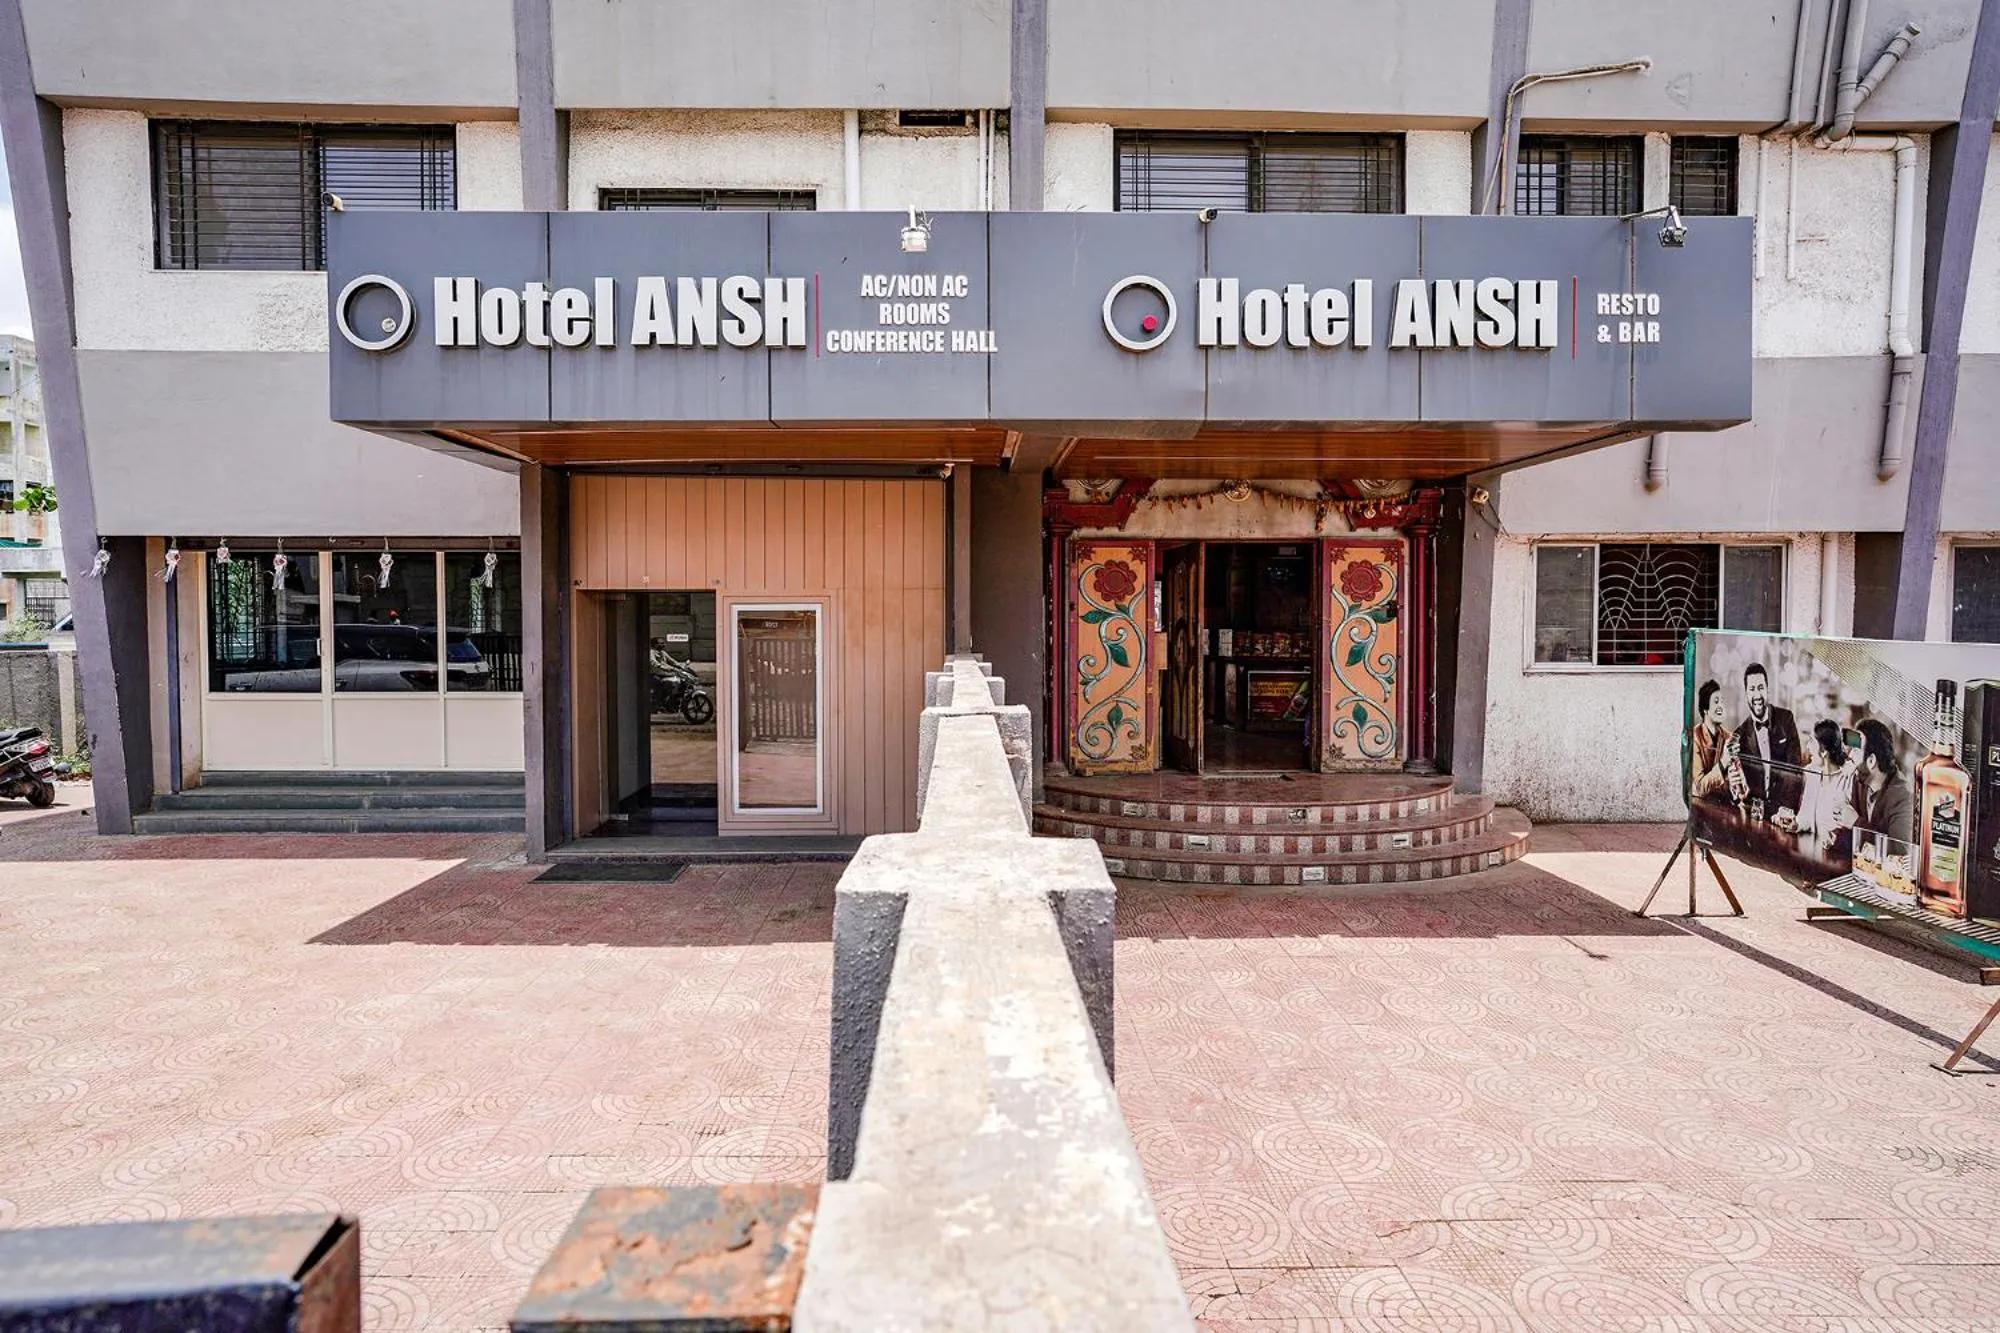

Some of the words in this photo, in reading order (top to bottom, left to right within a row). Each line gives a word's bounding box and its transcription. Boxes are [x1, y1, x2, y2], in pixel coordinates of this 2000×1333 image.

[860, 274, 937, 298] AC/NON
[941, 275, 968, 298] AC
[434, 276, 617, 347] Hotel
[630, 275, 807, 347] ANSH
[879, 302, 950, 325] ROOMS
[1198, 277, 1373, 349] Hotel
[1389, 276, 1558, 349] ANSH
[1597, 293, 1660, 316] RESTO
[826, 330, 945, 354] CONFERENCE
[951, 330, 998, 354] HALL
[1597, 324, 1612, 343] &
[1618, 321, 1660, 343] BAR
